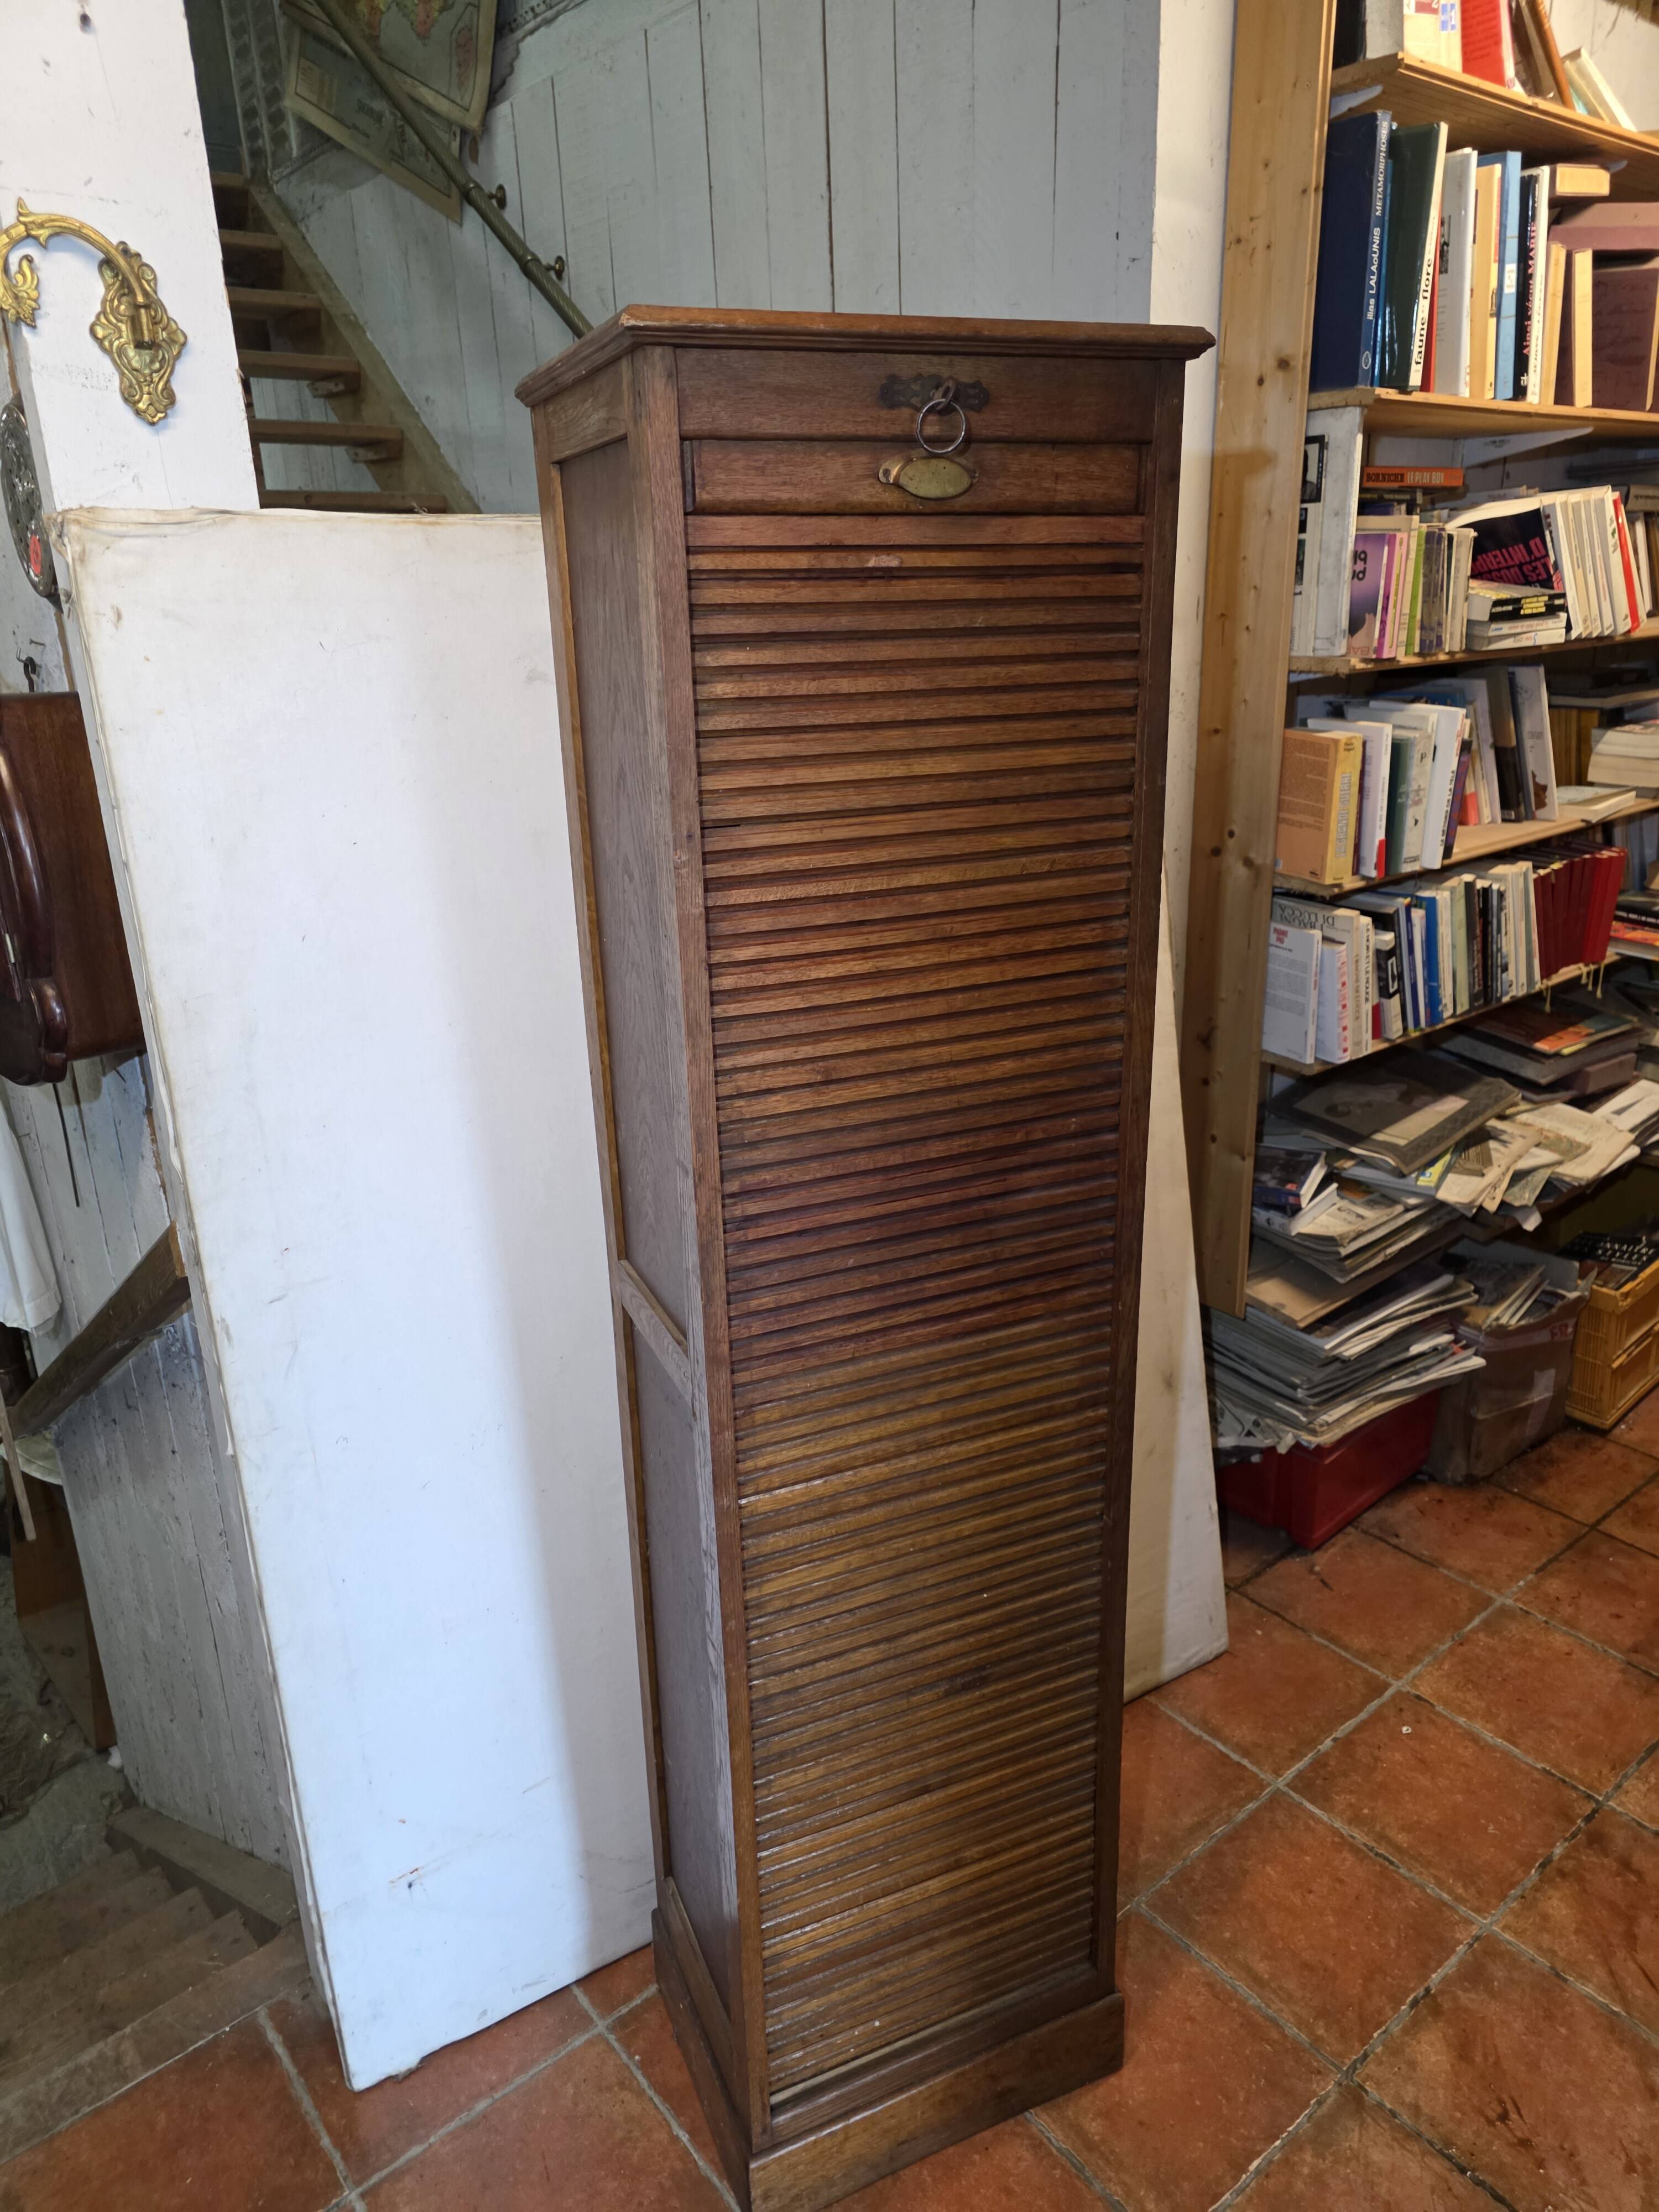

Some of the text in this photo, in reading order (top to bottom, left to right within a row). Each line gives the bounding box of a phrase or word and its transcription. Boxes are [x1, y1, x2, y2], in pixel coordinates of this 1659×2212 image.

[1376, 121, 1388, 216] METAMORPHOSES
[1415, 317, 1426, 366] faune
[1422, 258, 1432, 300] flore
[1366, 472, 1405, 483] BORNICHE
[1407, 472, 1413, 484] LE
[1415, 472, 1430, 484] PLAY
[1432, 472, 1445, 484] BOY
[1340, 771, 1352, 808] GUERRE
[1336, 810, 1349, 846] GRANDE
[1279, 905, 1335, 926] DI LUCCA
